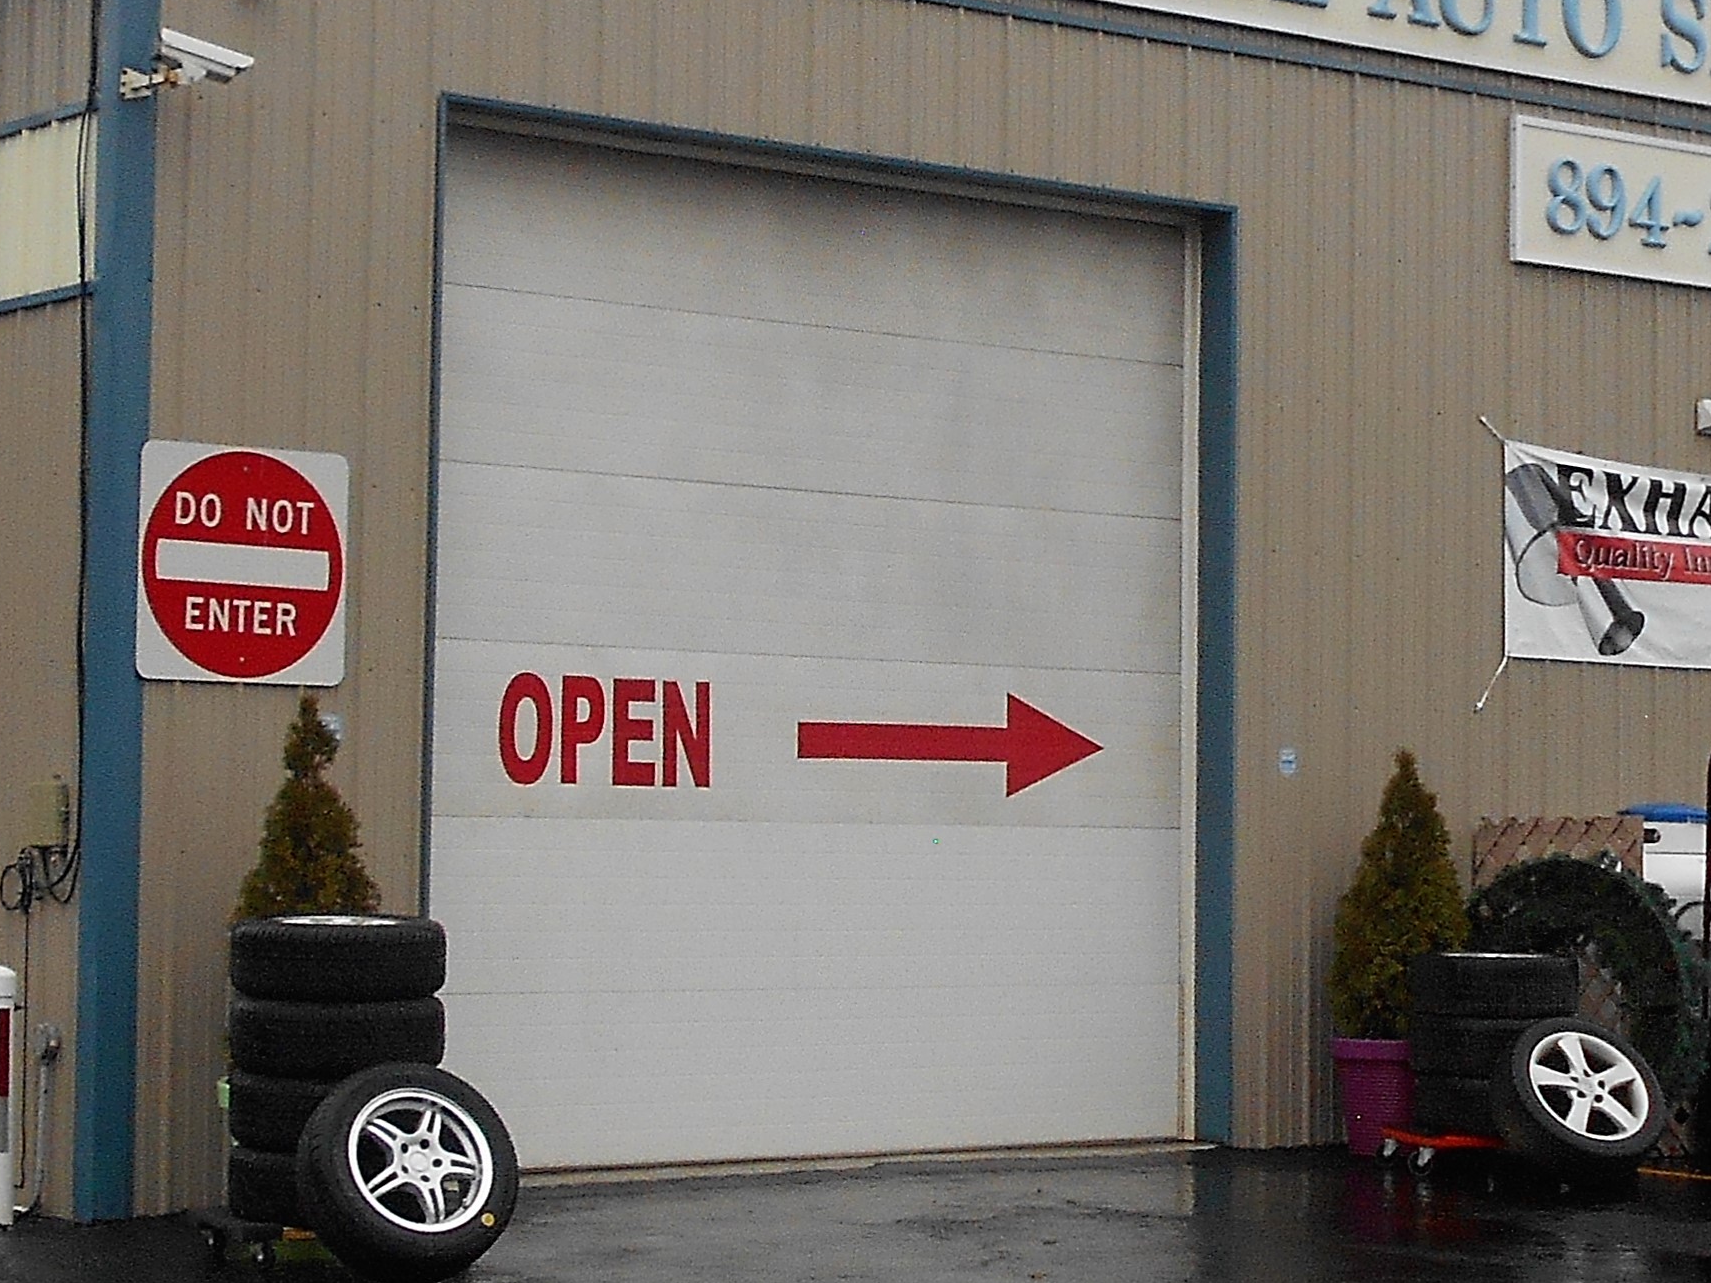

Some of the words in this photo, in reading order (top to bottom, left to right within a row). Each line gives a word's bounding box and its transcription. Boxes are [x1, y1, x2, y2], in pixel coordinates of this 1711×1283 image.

[174, 490, 223, 529] DO
[245, 497, 315, 536] NOT
[1575, 536, 1676, 580] Quality
[183, 594, 298, 639] ENTER
[496, 668, 714, 789] OPEN
